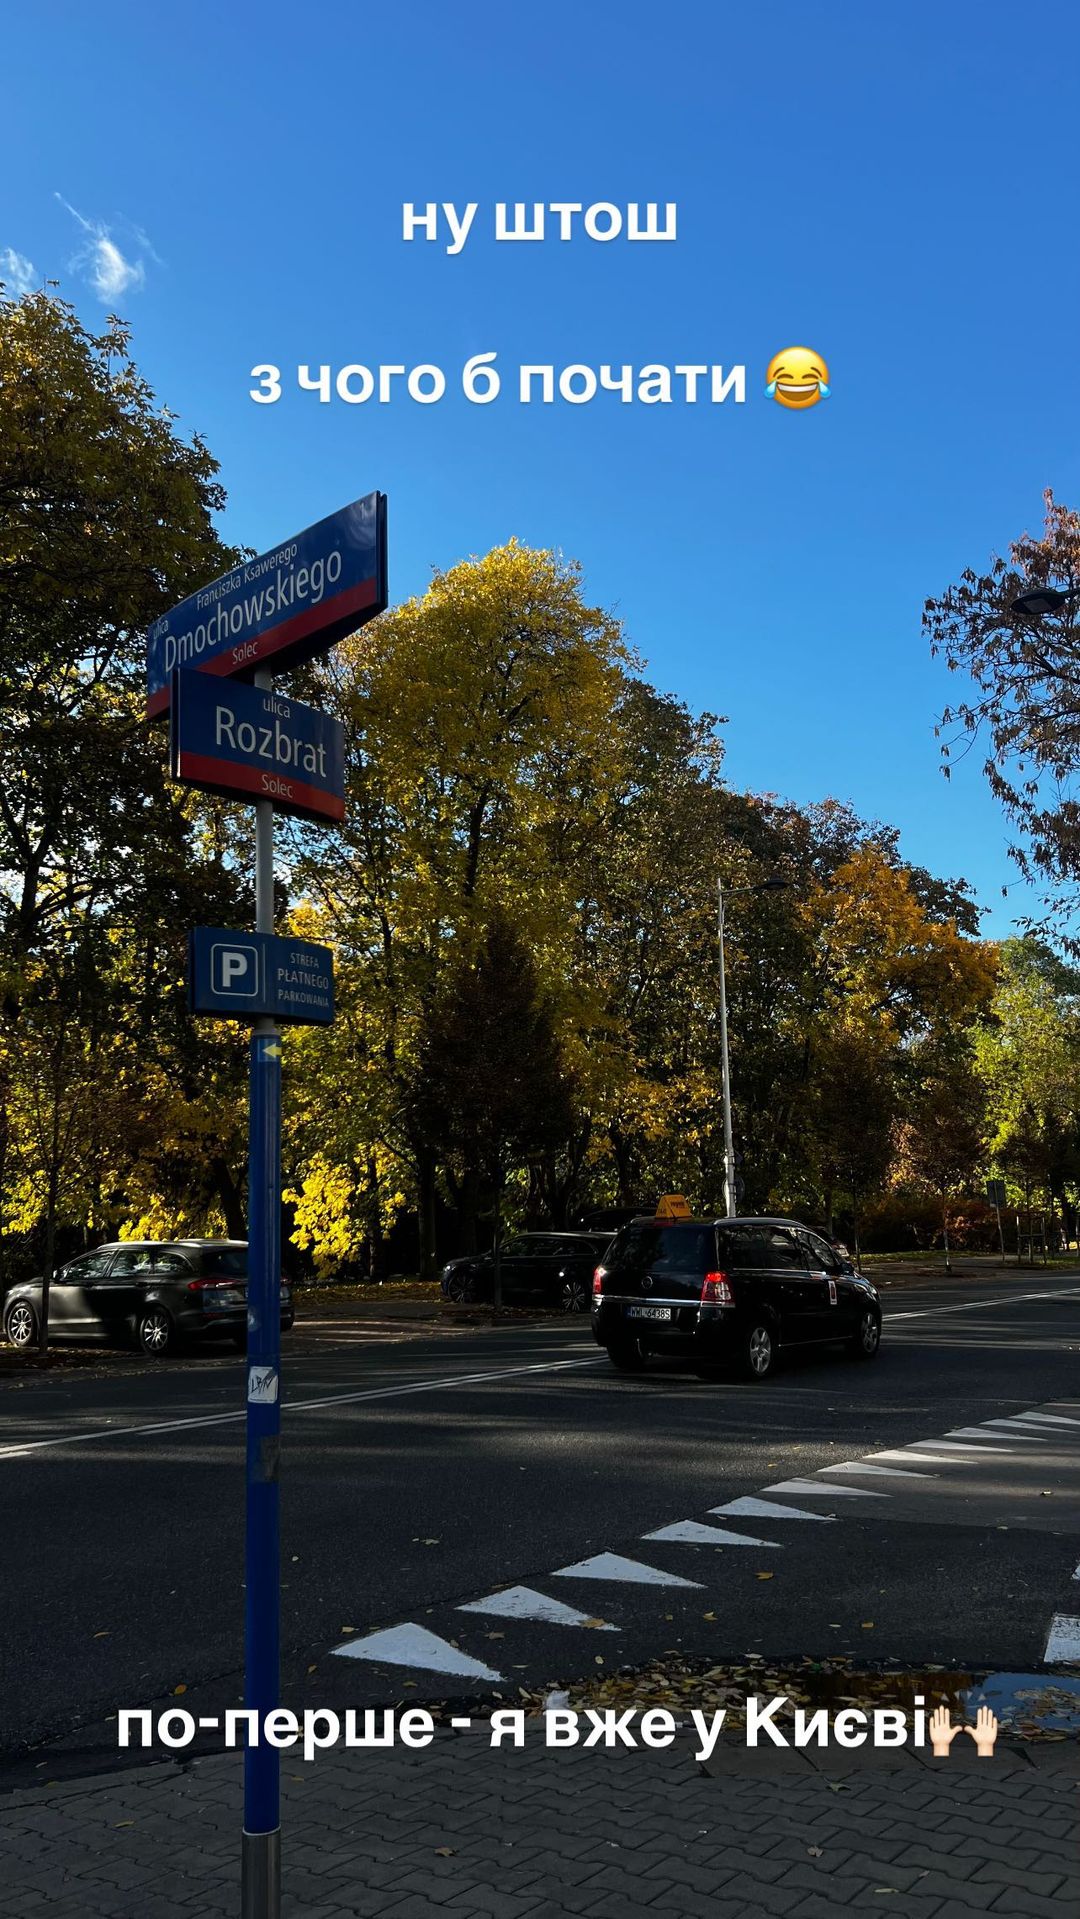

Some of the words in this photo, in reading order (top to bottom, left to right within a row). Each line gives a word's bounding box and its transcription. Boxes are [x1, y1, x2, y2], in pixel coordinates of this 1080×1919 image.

[197, 574, 241, 611] Franciszka
[244, 543, 298, 583] Ksawerego
[165, 551, 342, 672] Dmochowskiego
[232, 642, 259, 664] Solec
[263, 698, 291, 719] ulica
[216, 705, 327, 778] Rozbrat
[261, 774, 294, 799] Solec
[222, 951, 248, 988] P
[290, 952, 319, 968] STREFA
[277, 968, 329, 990] PŁATNEGO
[277, 989, 329, 1007] PARKOWANIA
